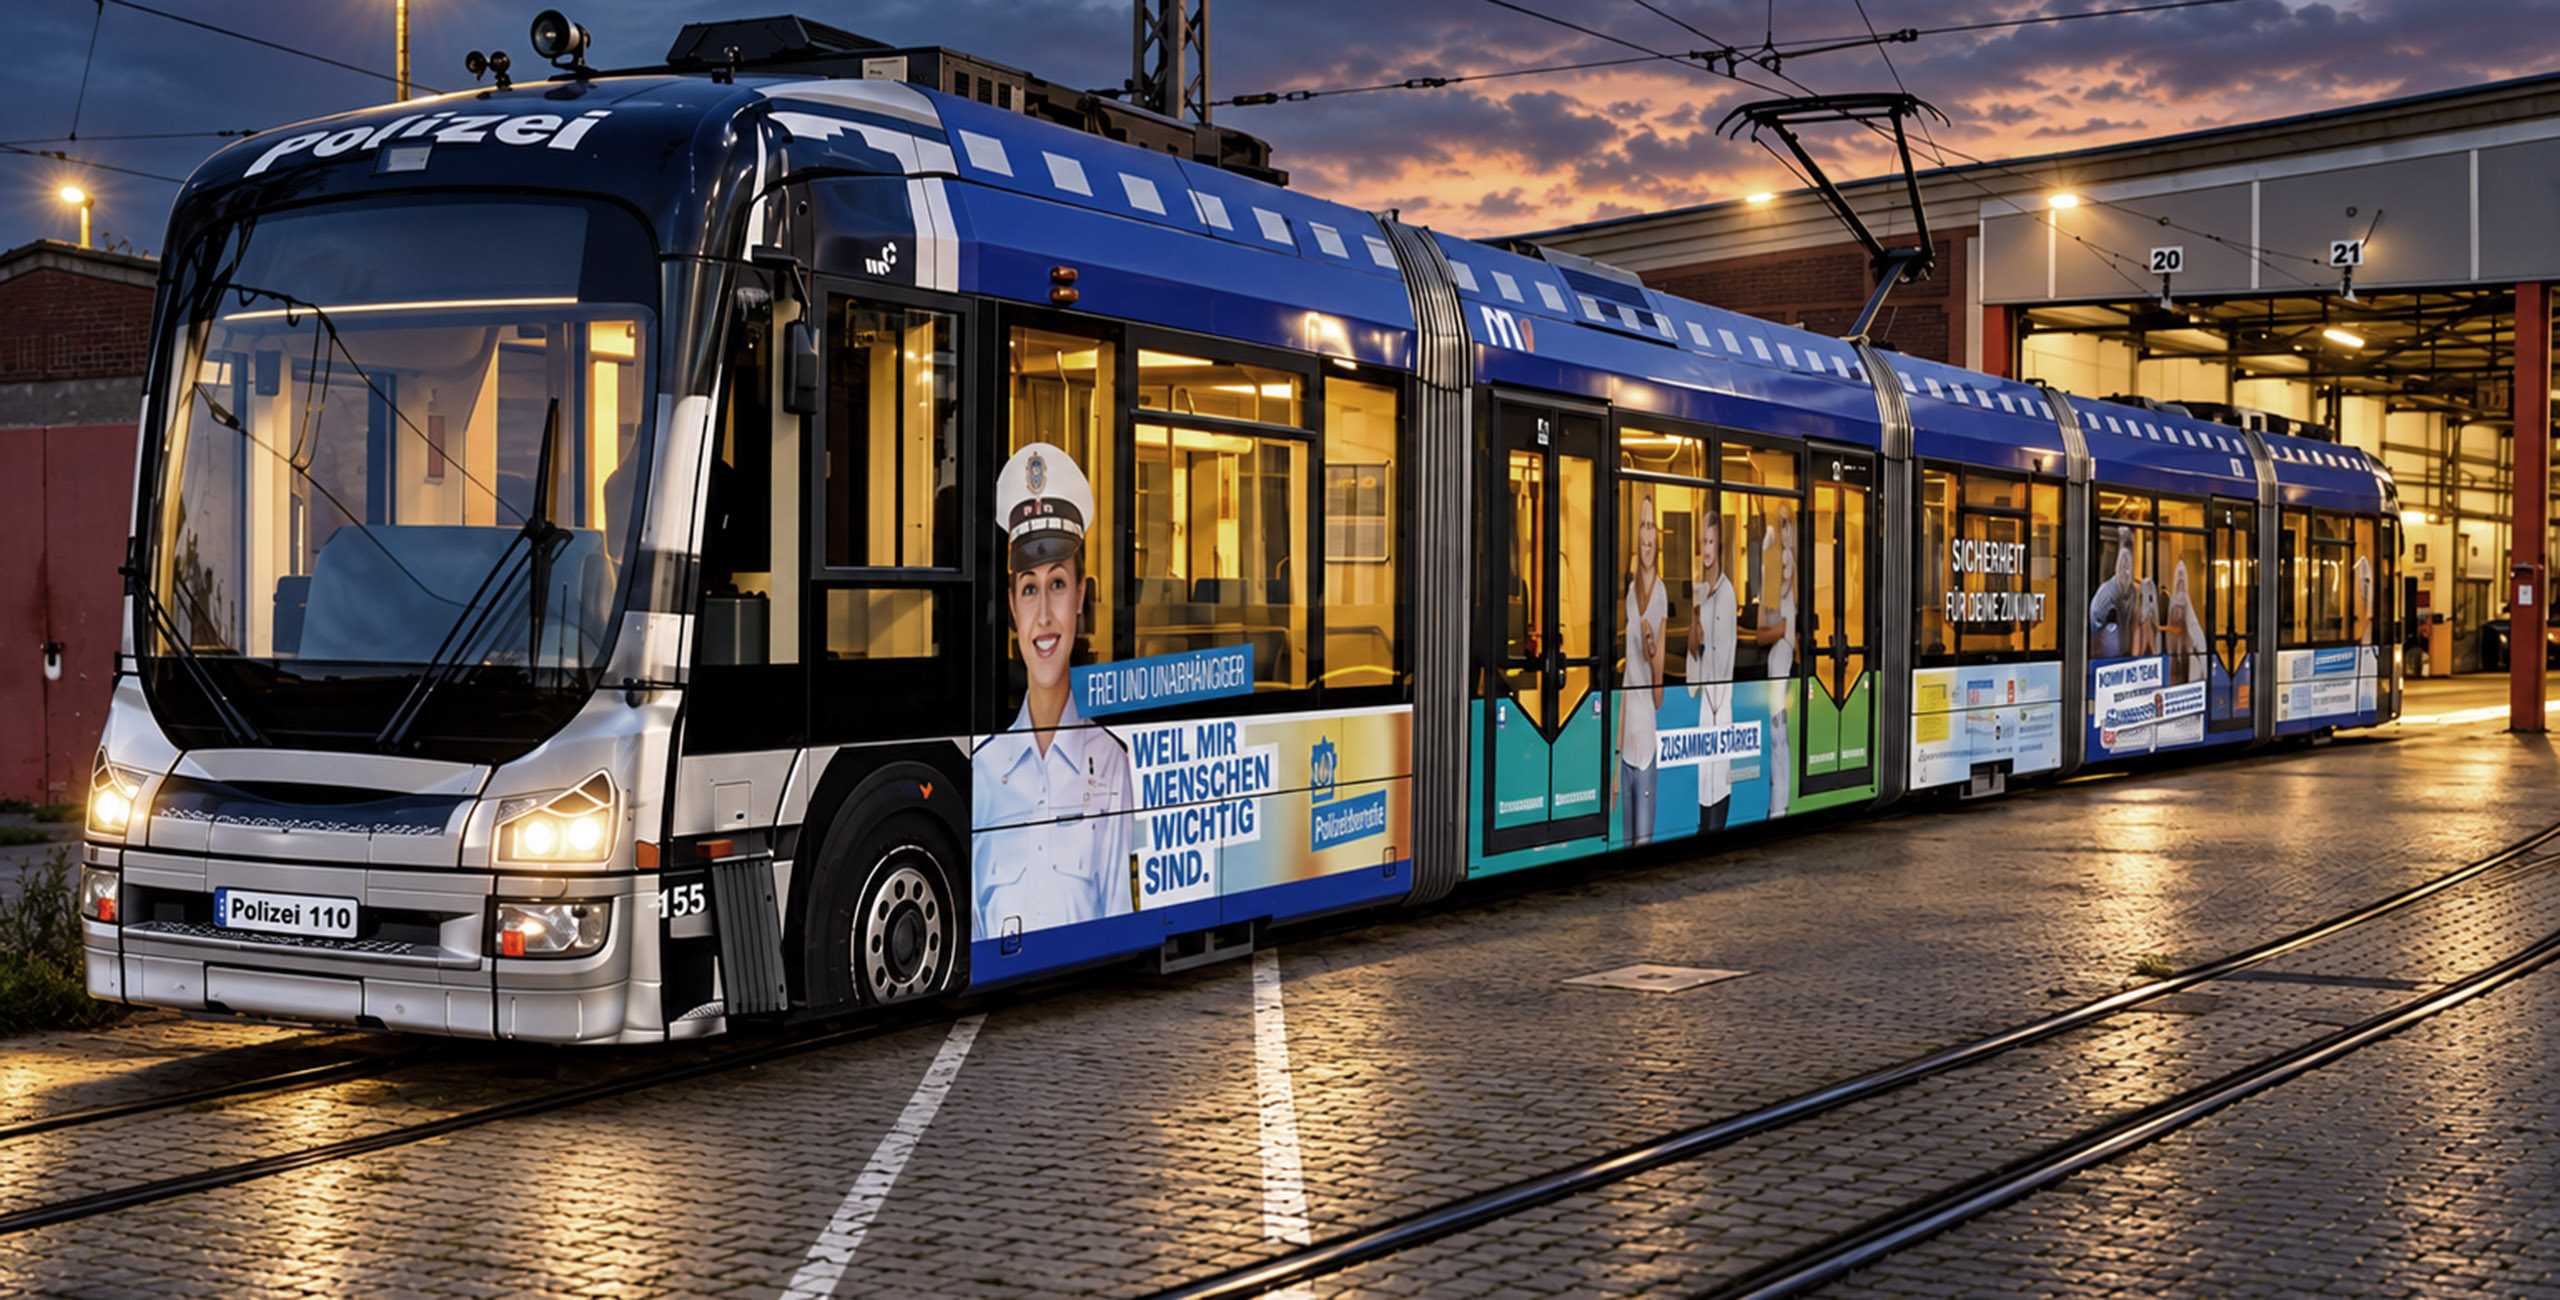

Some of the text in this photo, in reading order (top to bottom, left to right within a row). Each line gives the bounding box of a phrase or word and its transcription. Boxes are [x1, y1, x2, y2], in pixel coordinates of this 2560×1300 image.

[2153, 250, 2180, 270] 20
[2333, 242, 2360, 264] 21
[1952, 538, 2025, 575] SICHERHEIT
[1088, 671, 1117, 706] FREI
[1121, 666, 1148, 702] UND
[1132, 721, 1236, 769] WEIL MIR
[1661, 731, 1718, 762] ZUSAMMEN
[1143, 753, 1270, 810] MENSCHEN
[1152, 798, 1254, 851] WICHTIG
[1145, 850, 1209, 895] SIND.
[232, 898, 350, 929] Polizei 110
[659, 883, 706, 918] 155
